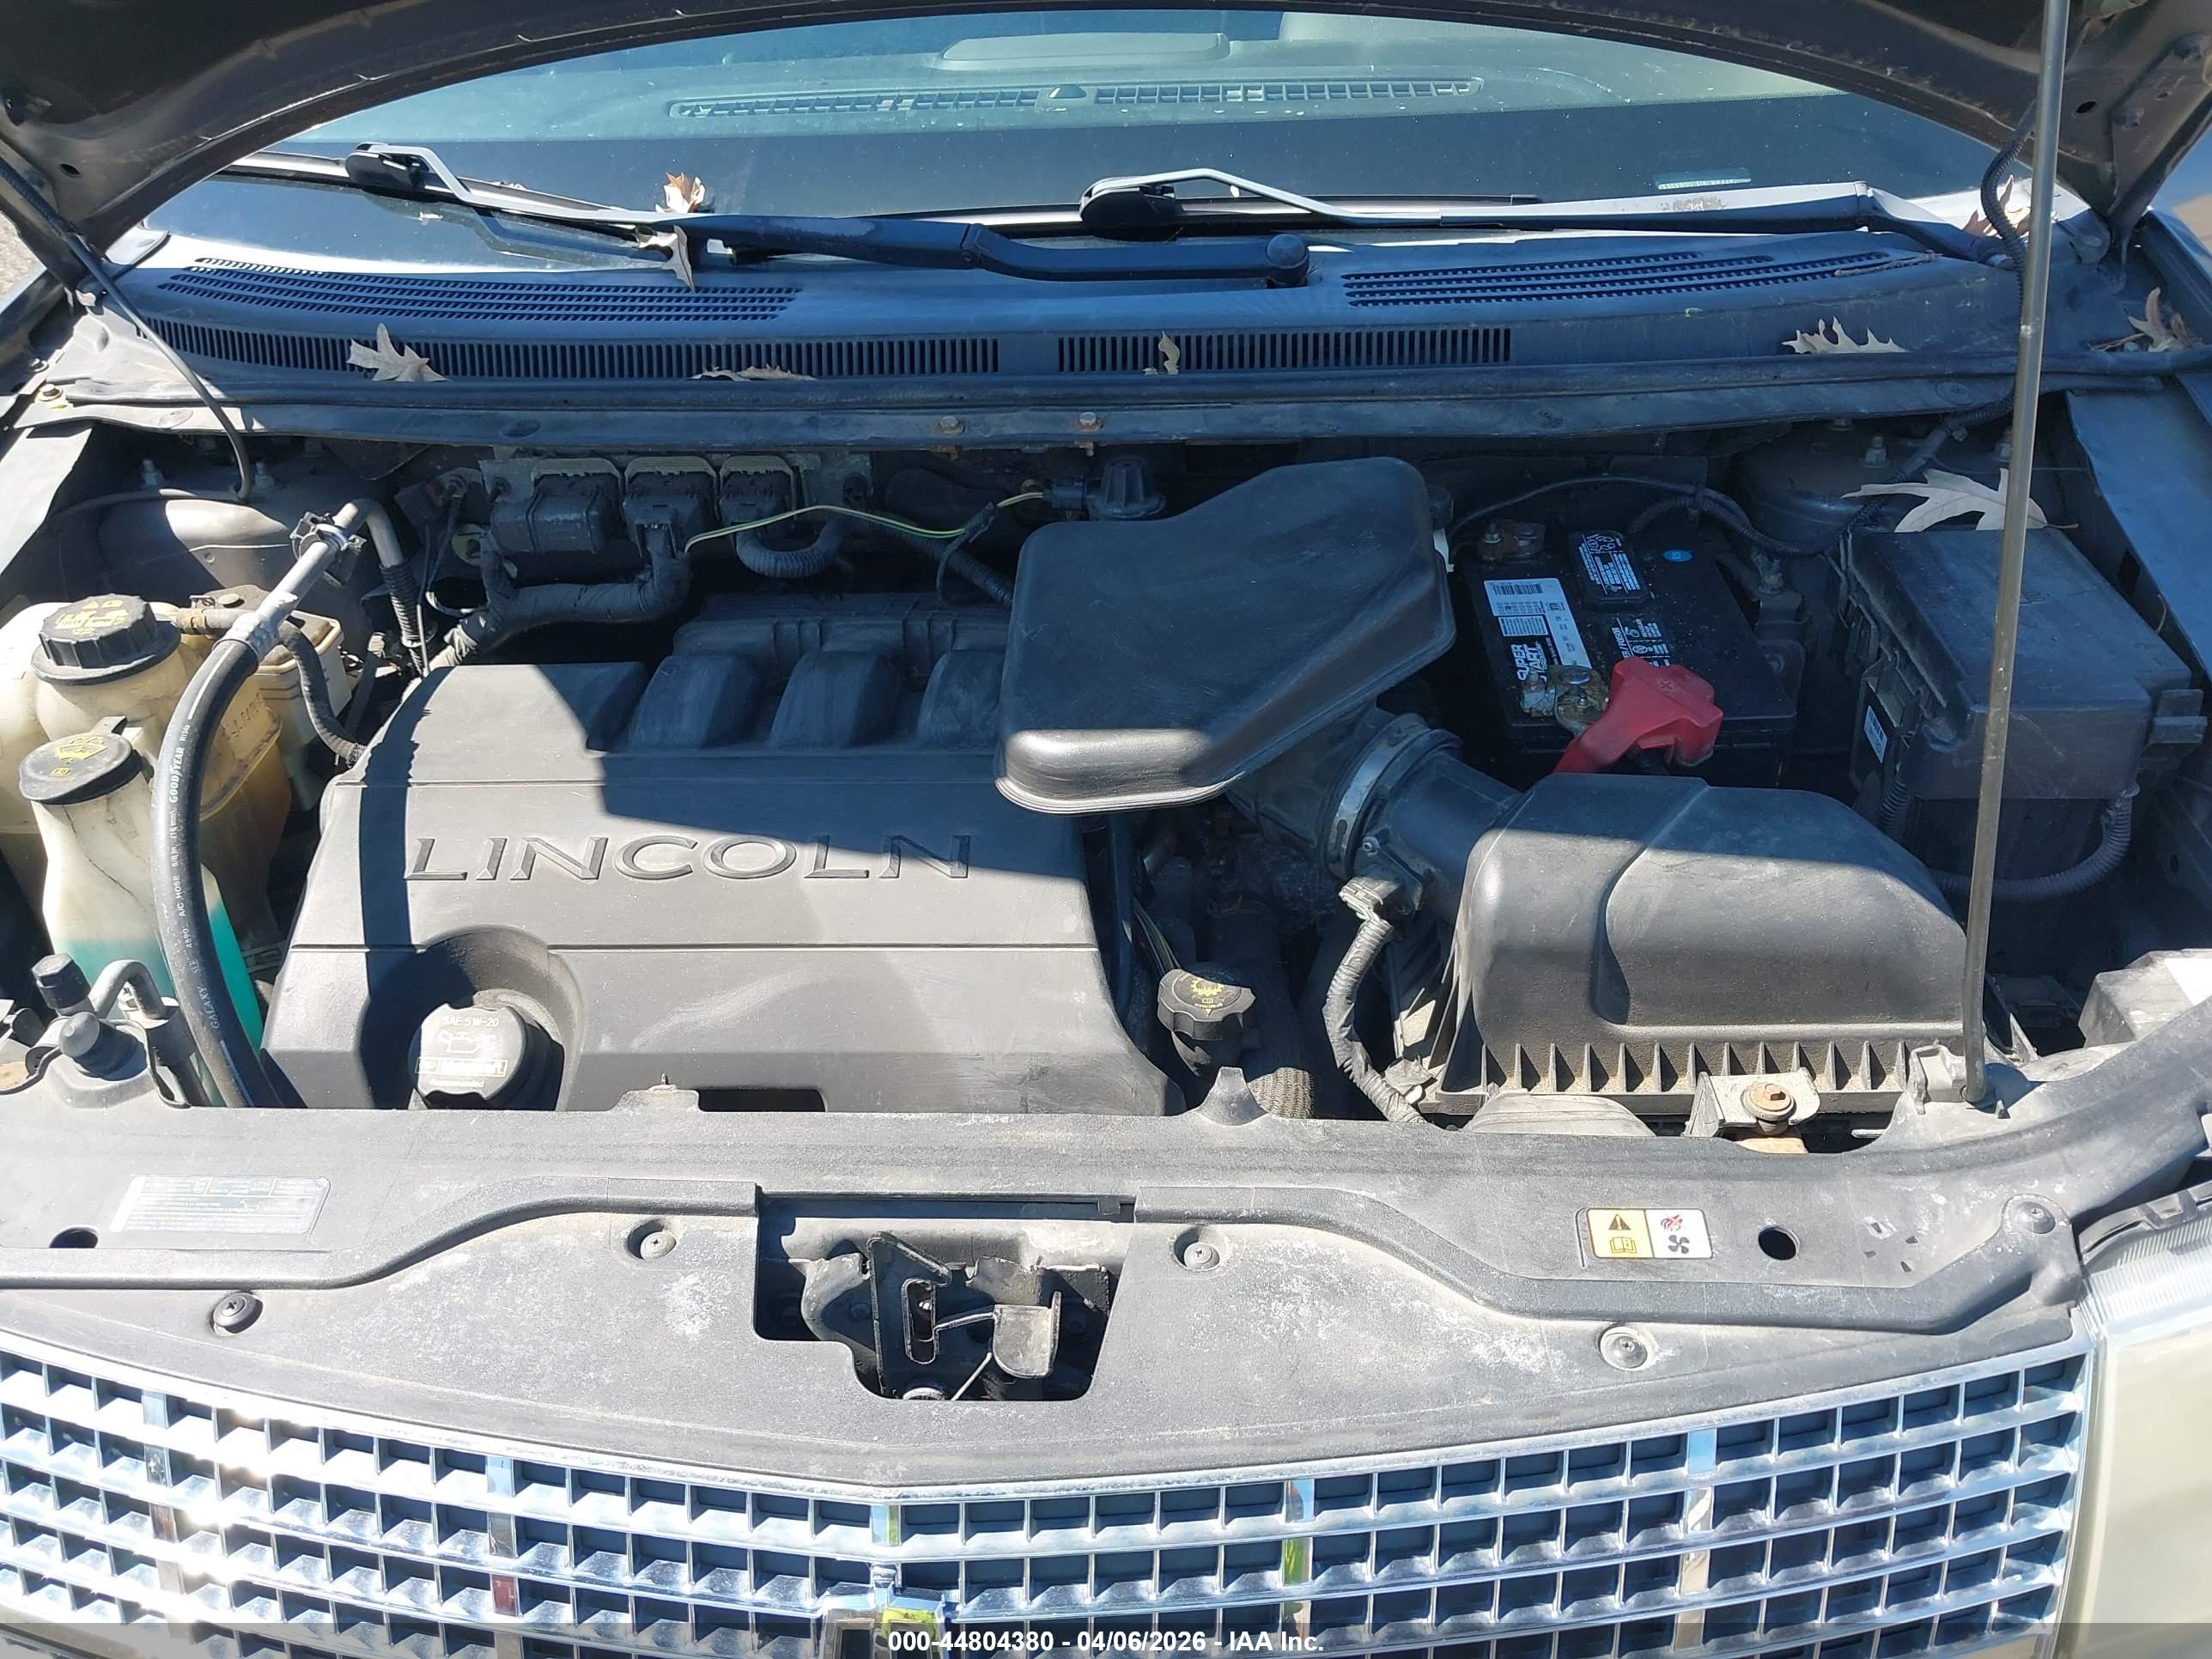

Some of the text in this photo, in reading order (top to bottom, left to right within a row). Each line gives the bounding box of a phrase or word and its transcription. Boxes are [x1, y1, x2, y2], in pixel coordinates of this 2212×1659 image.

[1511, 644, 1529, 680] SUPER
[169, 747, 185, 803] GOODYEAR
[404, 836, 971, 881] LINCOLN
[173, 875, 183, 898] HOSE
[198, 986, 220, 1029] GALAXY
